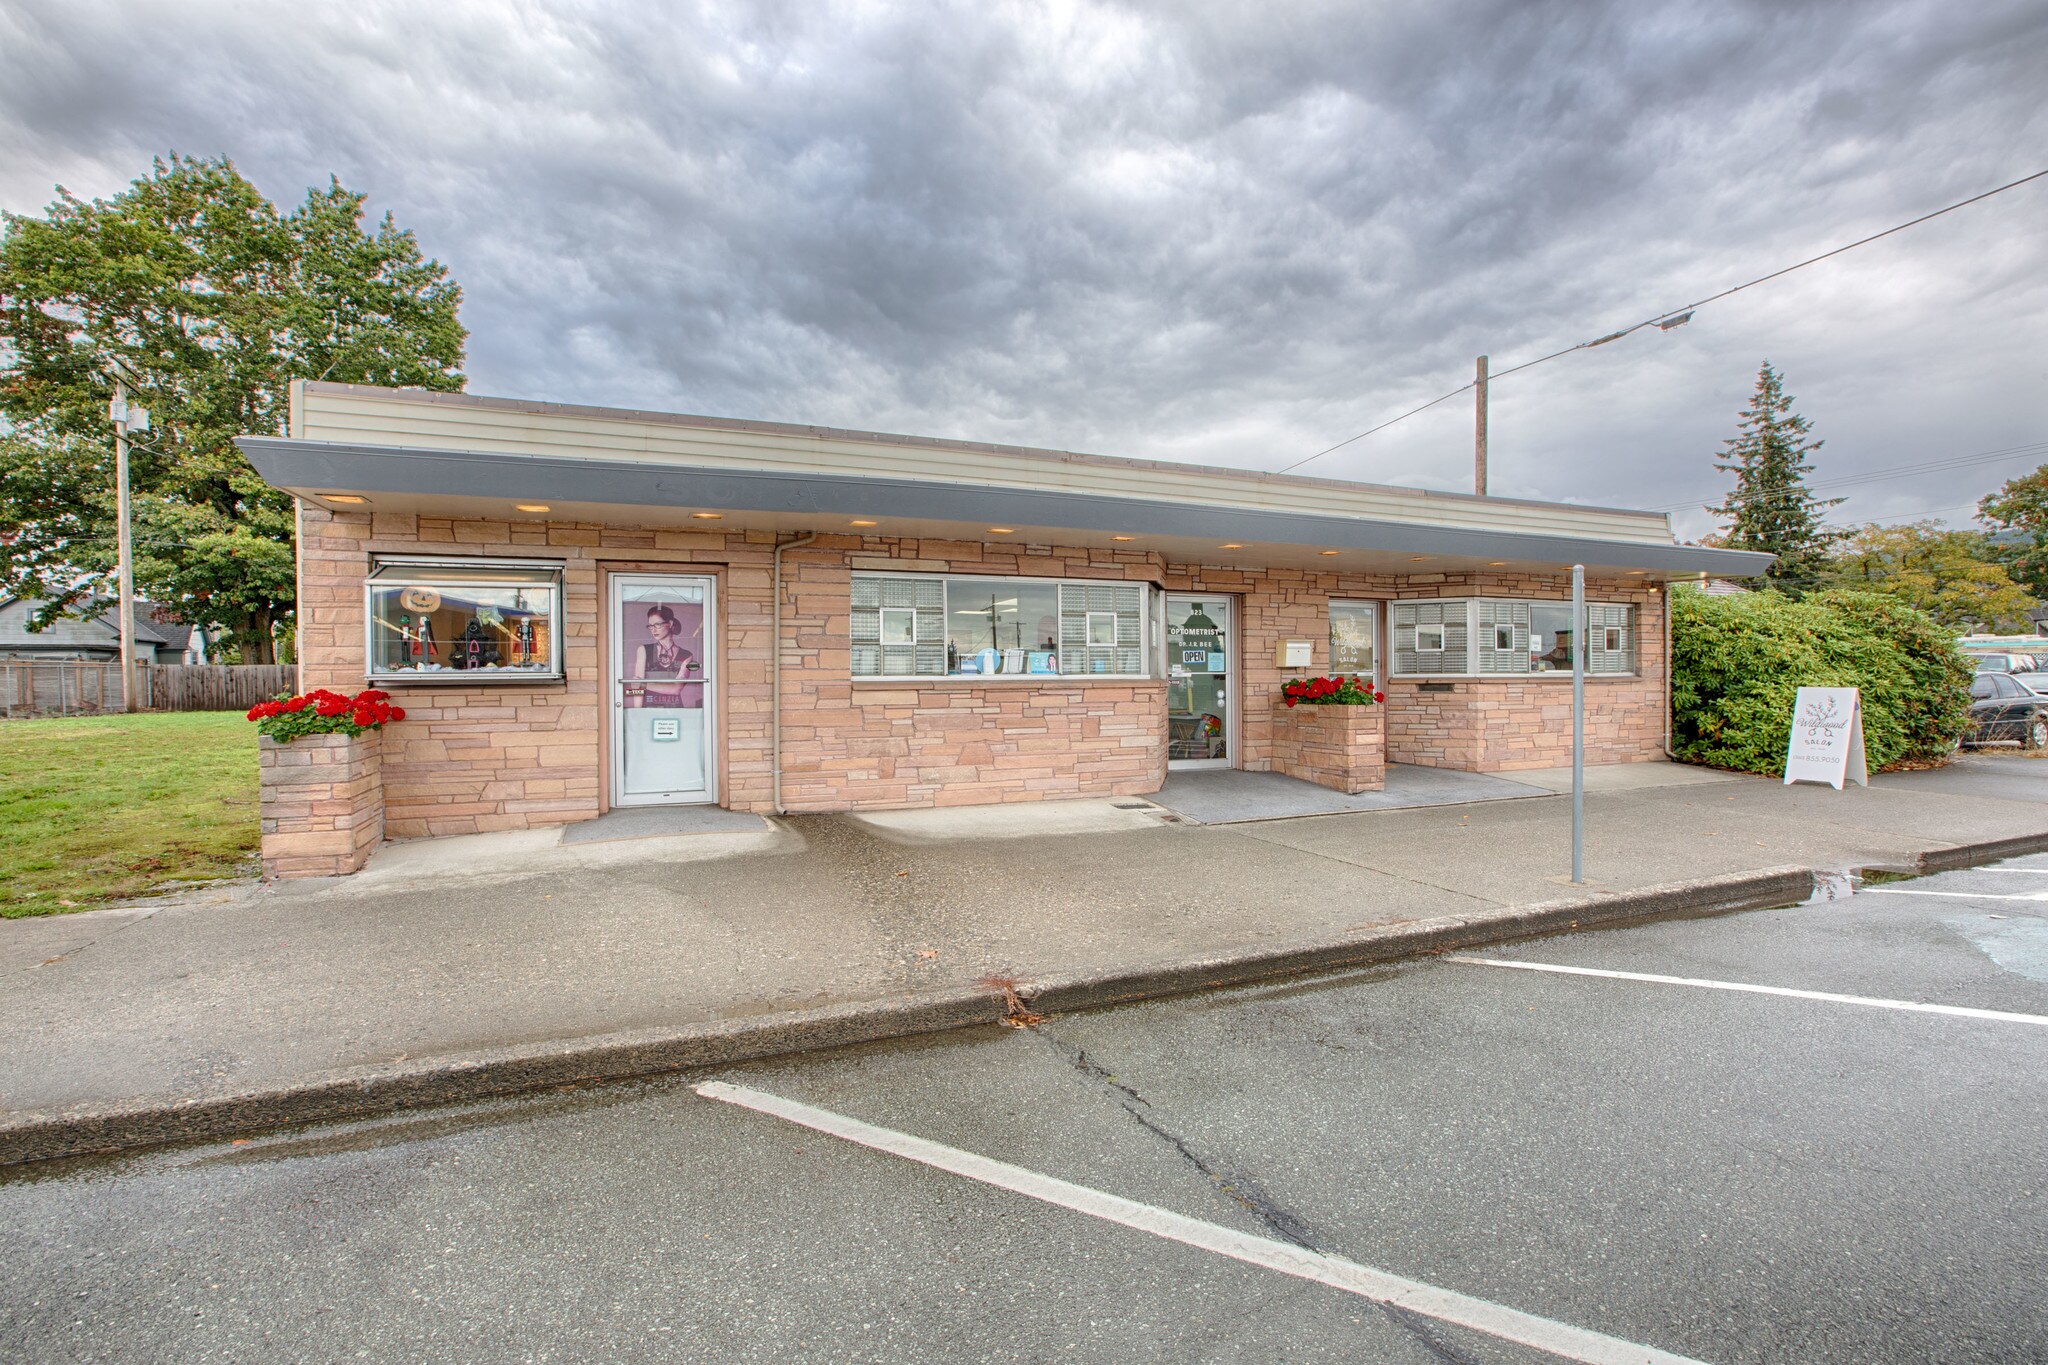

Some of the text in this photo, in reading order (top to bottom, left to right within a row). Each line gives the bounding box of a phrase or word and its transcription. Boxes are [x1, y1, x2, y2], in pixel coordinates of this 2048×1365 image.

[1170, 628, 1219, 636] OPTOMETRIST
[1184, 651, 1204, 662] OPEN
[1795, 718, 1848, 729] Wildwood
[1804, 739, 1833, 747] SALON
